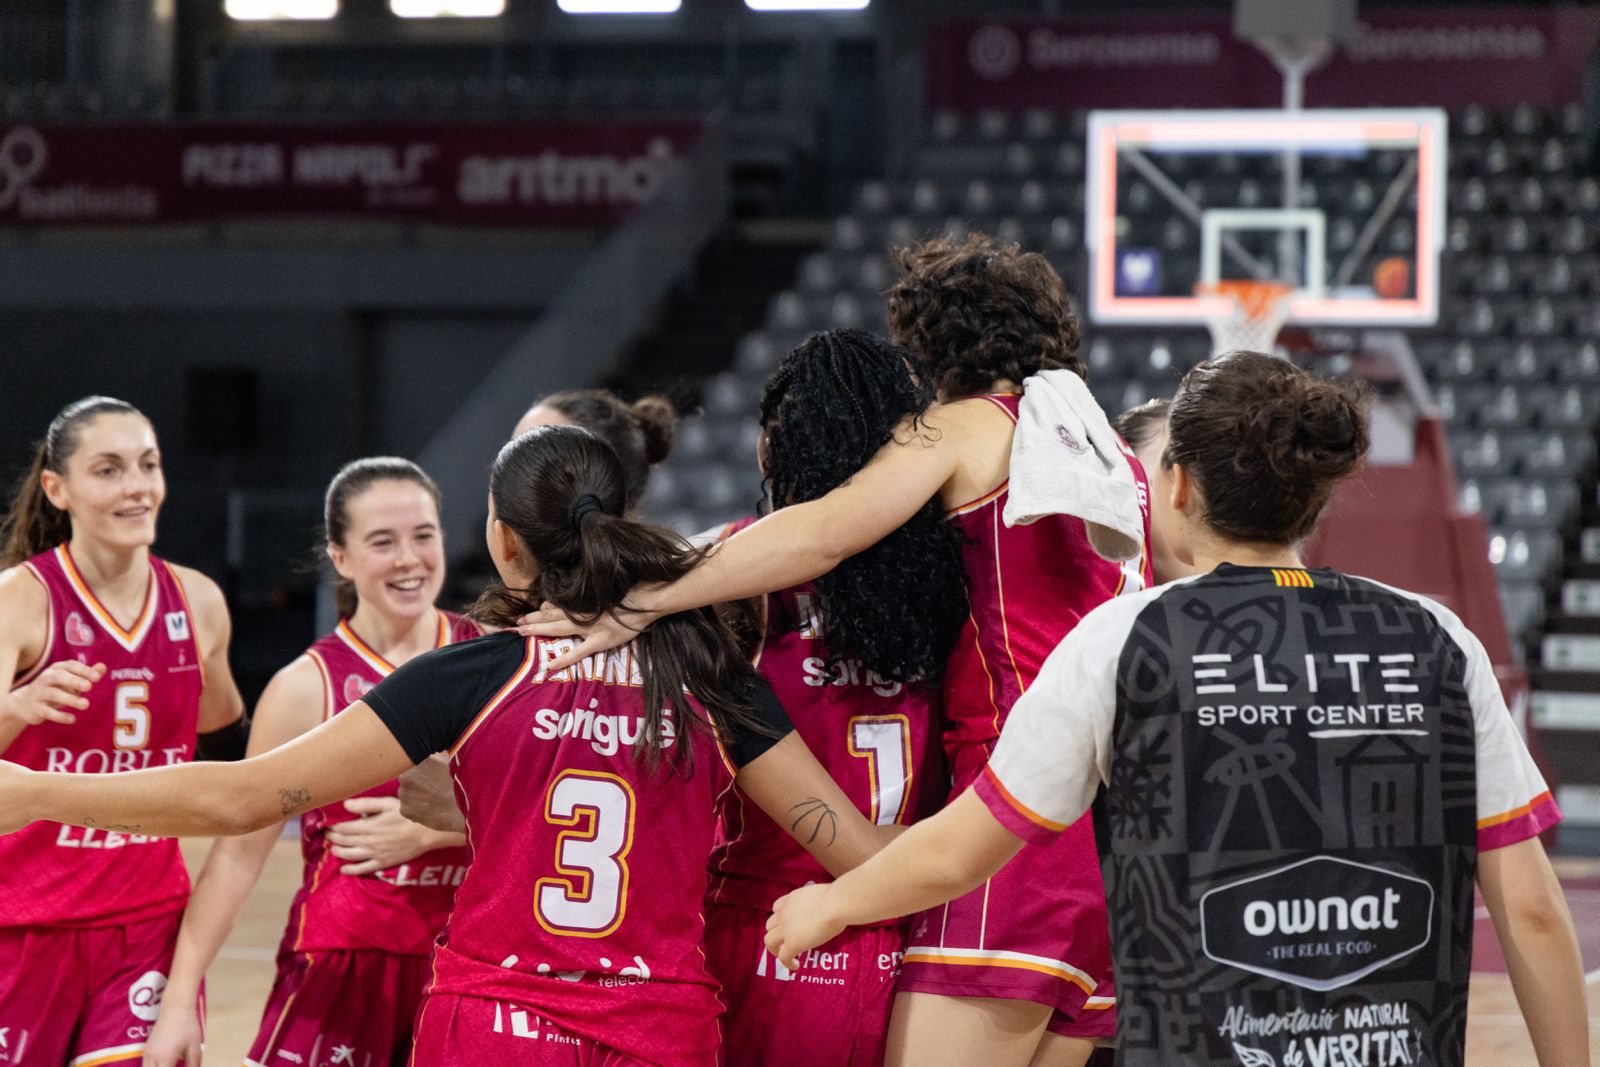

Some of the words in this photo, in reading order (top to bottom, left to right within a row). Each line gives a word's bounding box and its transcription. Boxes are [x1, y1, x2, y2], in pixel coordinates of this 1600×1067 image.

[1192, 654, 1419, 695] ELITE
[112, 681, 151, 751] 5
[1197, 705, 1297, 726] SPORT
[1306, 703, 1425, 726] CENTER
[848, 714, 912, 826] 1
[534, 768, 636, 939] 3
[1243, 888, 1401, 936] ownat
[1298, 942, 1332, 957] REAL
[1344, 1001, 1410, 1029] NATURAL
[1283, 1038, 1304, 1067] de
